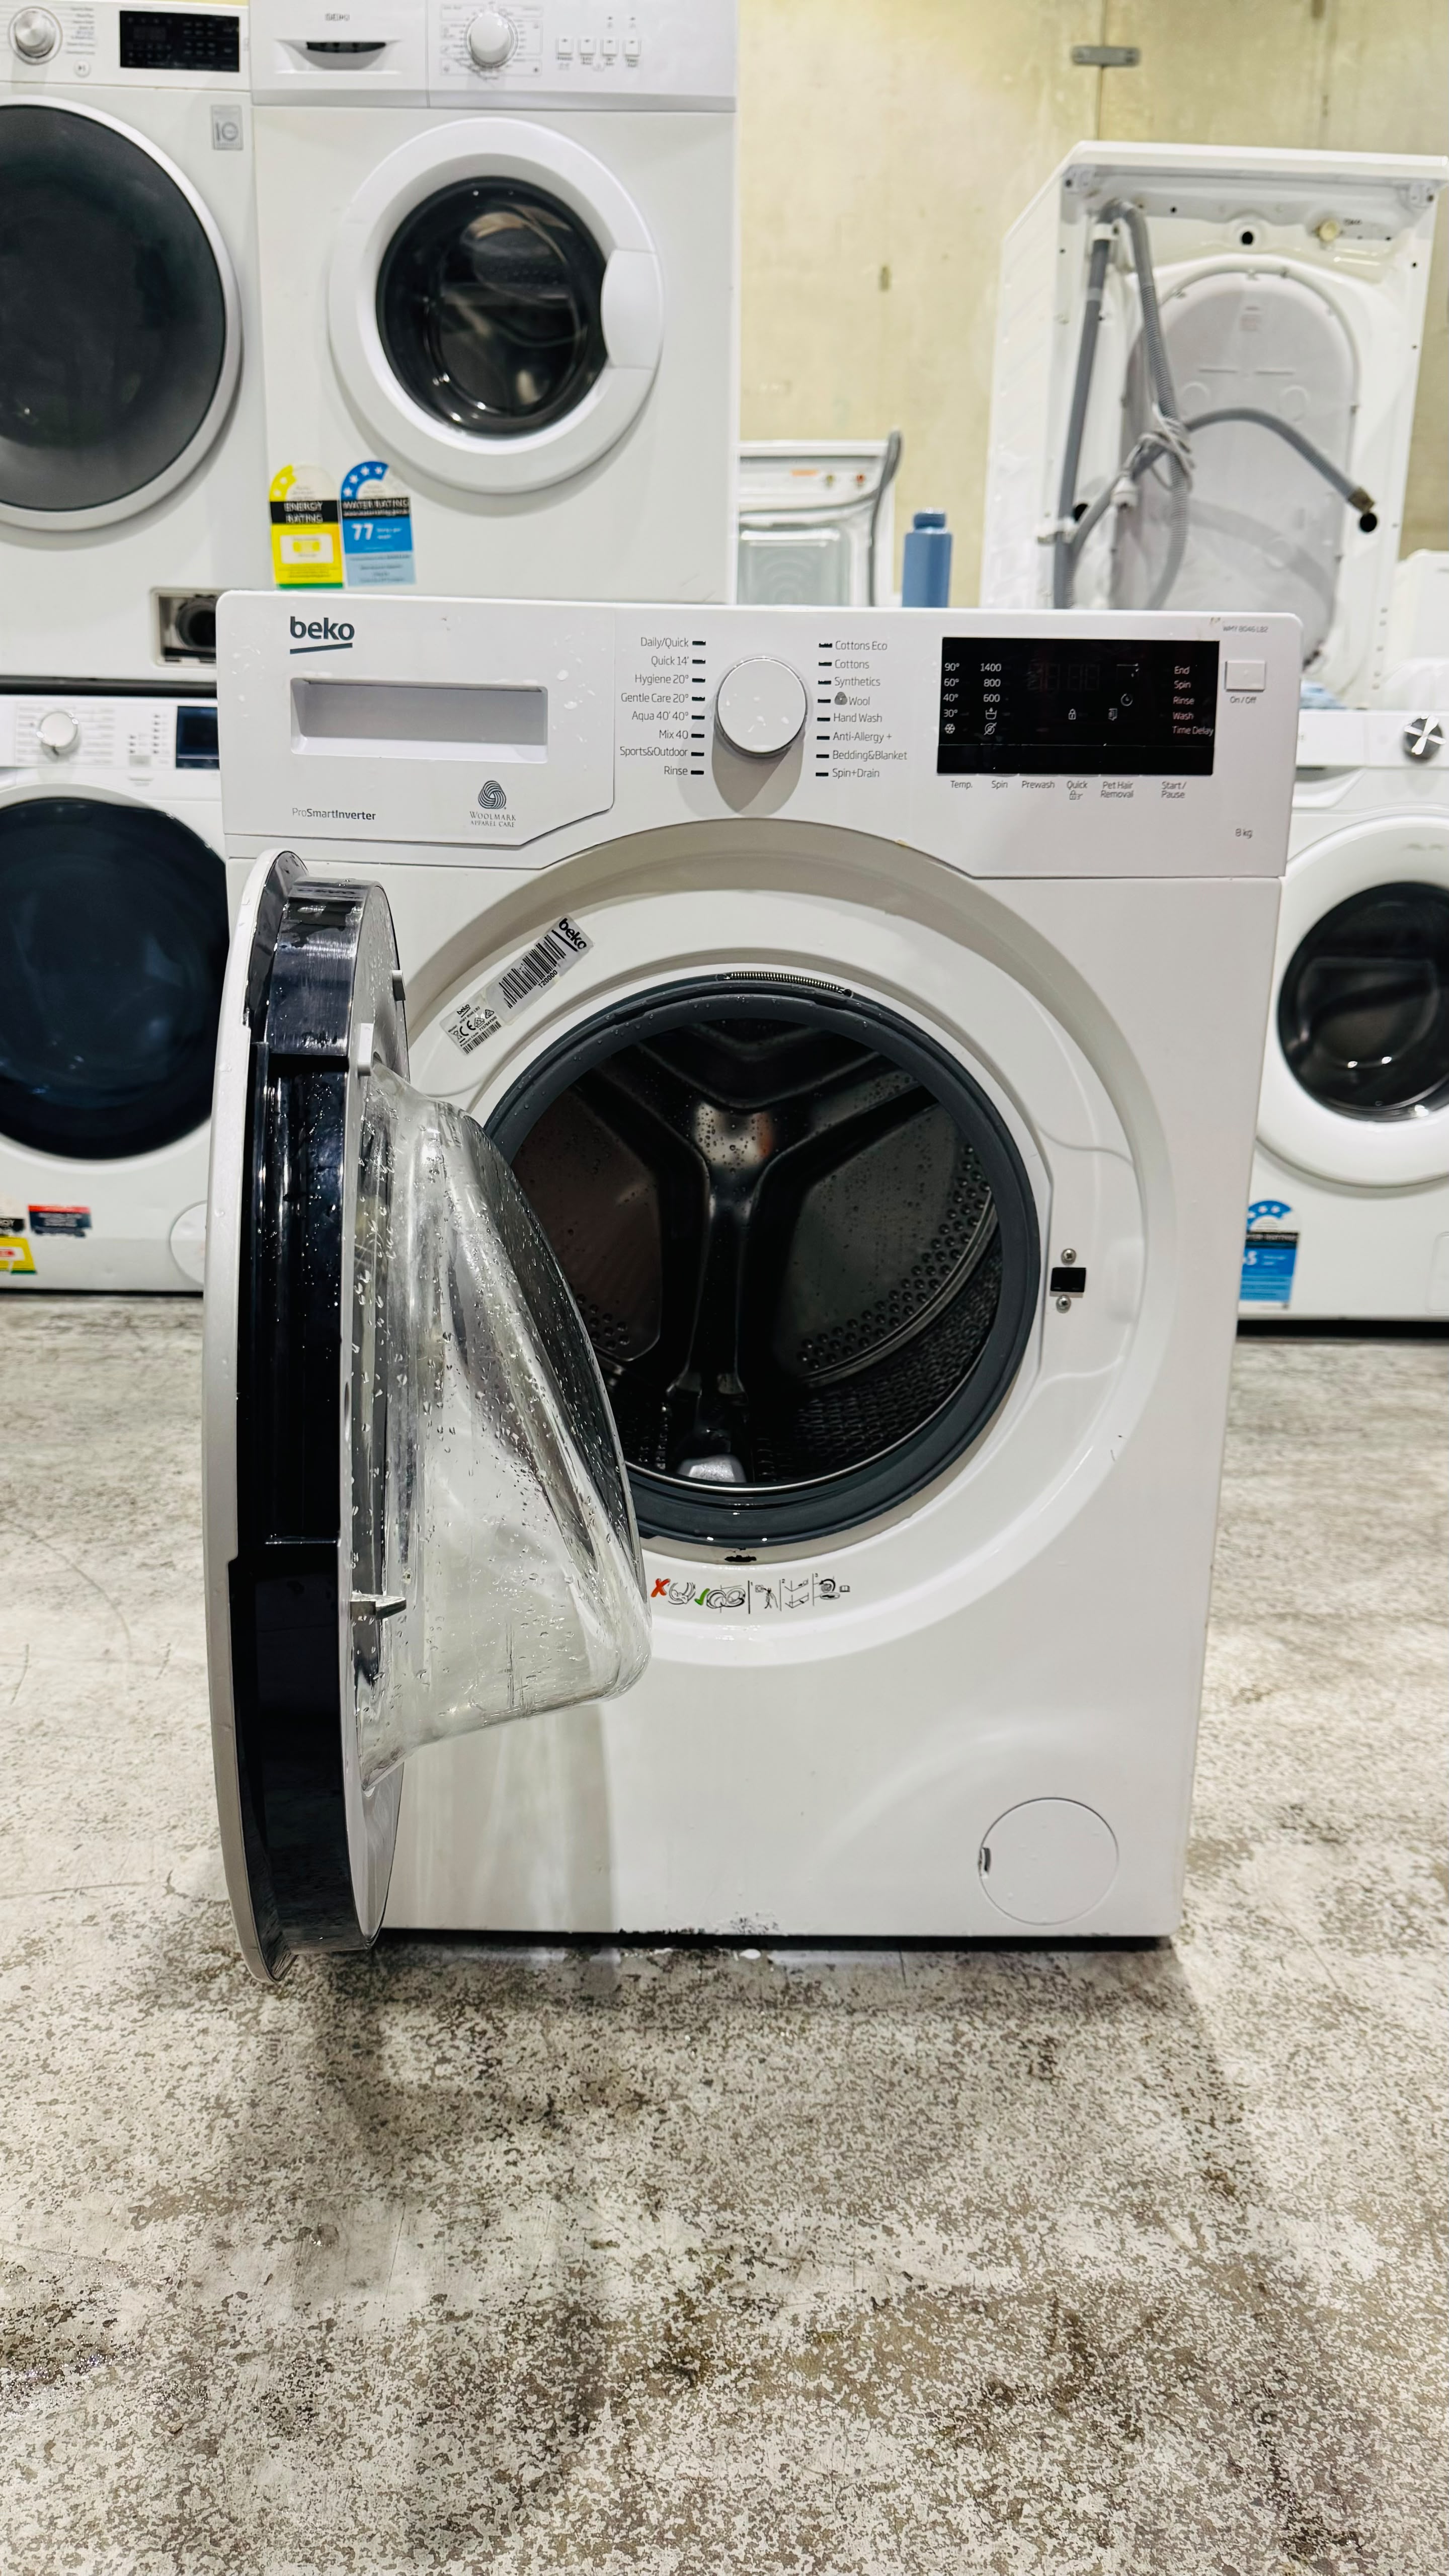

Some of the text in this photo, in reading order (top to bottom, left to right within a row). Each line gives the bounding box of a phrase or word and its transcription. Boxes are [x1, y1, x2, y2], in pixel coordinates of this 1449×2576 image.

[352, 523, 374, 540] 77
[290, 616, 355, 640] beko
[640, 637, 689, 649] Daily/Quick
[835, 640, 888, 651] Cottons Eco
[651, 656, 675, 667] Quick
[835, 659, 870, 669] Cottons
[980, 663, 1002, 672] 1400
[1174, 666, 1190, 675] End
[635, 674, 671, 686] Hygiene
[834, 677, 881, 688] Synthetics
[984, 679, 1001, 687] 800
[1174, 680, 1191, 690] Spin
[621, 692, 650, 702] Gentle
[652, 693, 671, 703] Care
[849, 696, 870, 706] Wool
[983, 694, 1000, 702] 600
[1173, 696, 1195, 705] Rinse
[632, 711, 655, 722] Aqua
[833, 713, 882, 722] Hand Wash
[1172, 712, 1194, 720] Wash
[659, 730, 689, 739] Mix 40
[1172, 726, 1214, 737] Time Delay
[833, 732, 884, 744] Anti-Allergy
[620, 747, 688, 757] Sports&Outdoor
[833, 750, 908, 762] Bedding&Blanket
[664, 766, 688, 775] Rinse
[832, 768, 880, 779] Spin+Drain
[950, 780, 973, 790] Temp.
[991, 780, 1008, 790] Spin
[1021, 780, 1055, 789] Prewash
[1066, 780, 1088, 790] Quick
[1102, 781, 1133, 789] Pet Hair
[1161, 790, 1185, 799] Pause
[292, 808, 376, 820] ProSmartInverter
[469, 811, 516, 821] WOOLMARK
[558, 918, 587, 949] beko
[456, 1004, 470, 1015] beko
